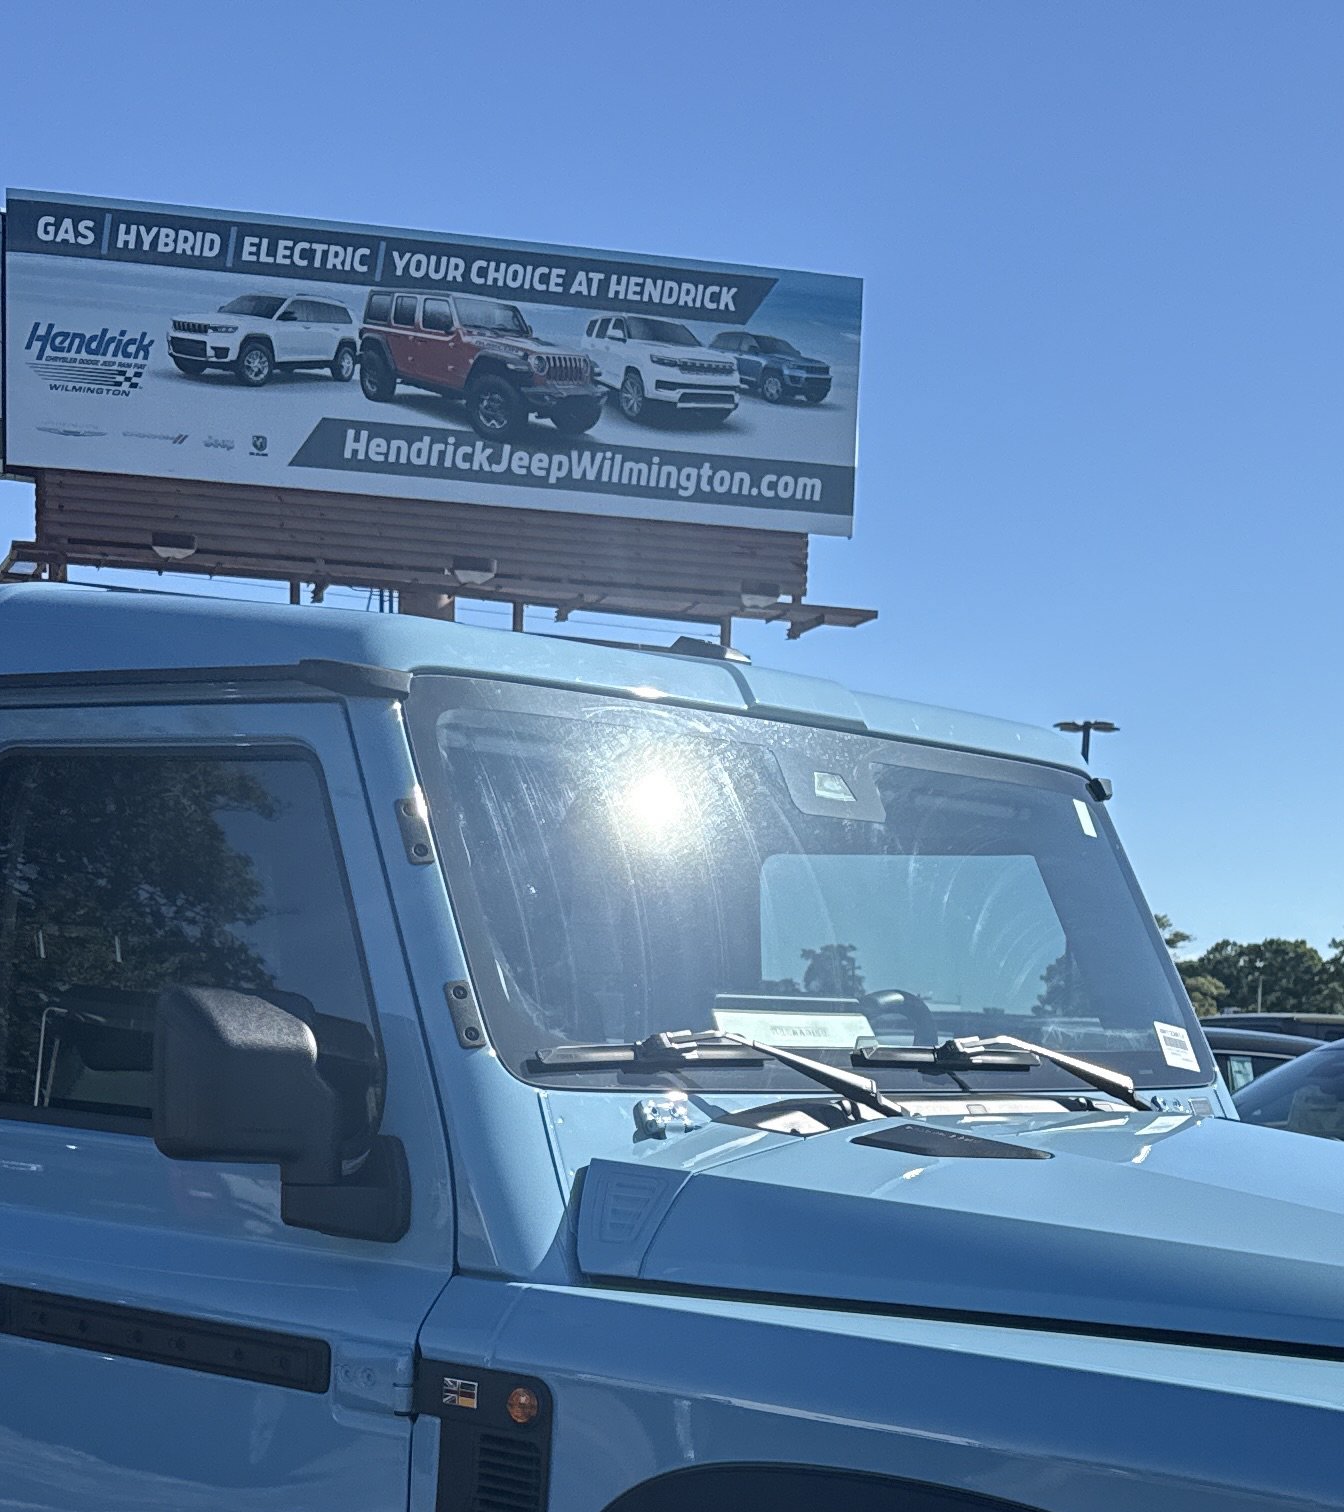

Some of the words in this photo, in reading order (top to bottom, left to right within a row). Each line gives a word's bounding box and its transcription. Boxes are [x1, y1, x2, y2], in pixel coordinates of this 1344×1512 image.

[36, 215, 96, 246] GAS
[116, 223, 222, 258] HYBRID
[241, 236, 372, 273] ELECTRIC
[392, 250, 466, 283] YOUR
[469, 260, 567, 293] CHOICE
[569, 270, 606, 297] AT
[608, 274, 738, 312] HENDRICK
[24, 321, 155, 361] Hendrick
[44, 355, 77, 364] CHRYSLER
[78, 358, 100, 366] DODGE
[100, 360, 116, 368] JEEP
[117, 361, 133, 369] RAM
[48, 383, 131, 397] WILMINGTON
[343, 428, 822, 501] HendrickJeepWilmington.com
